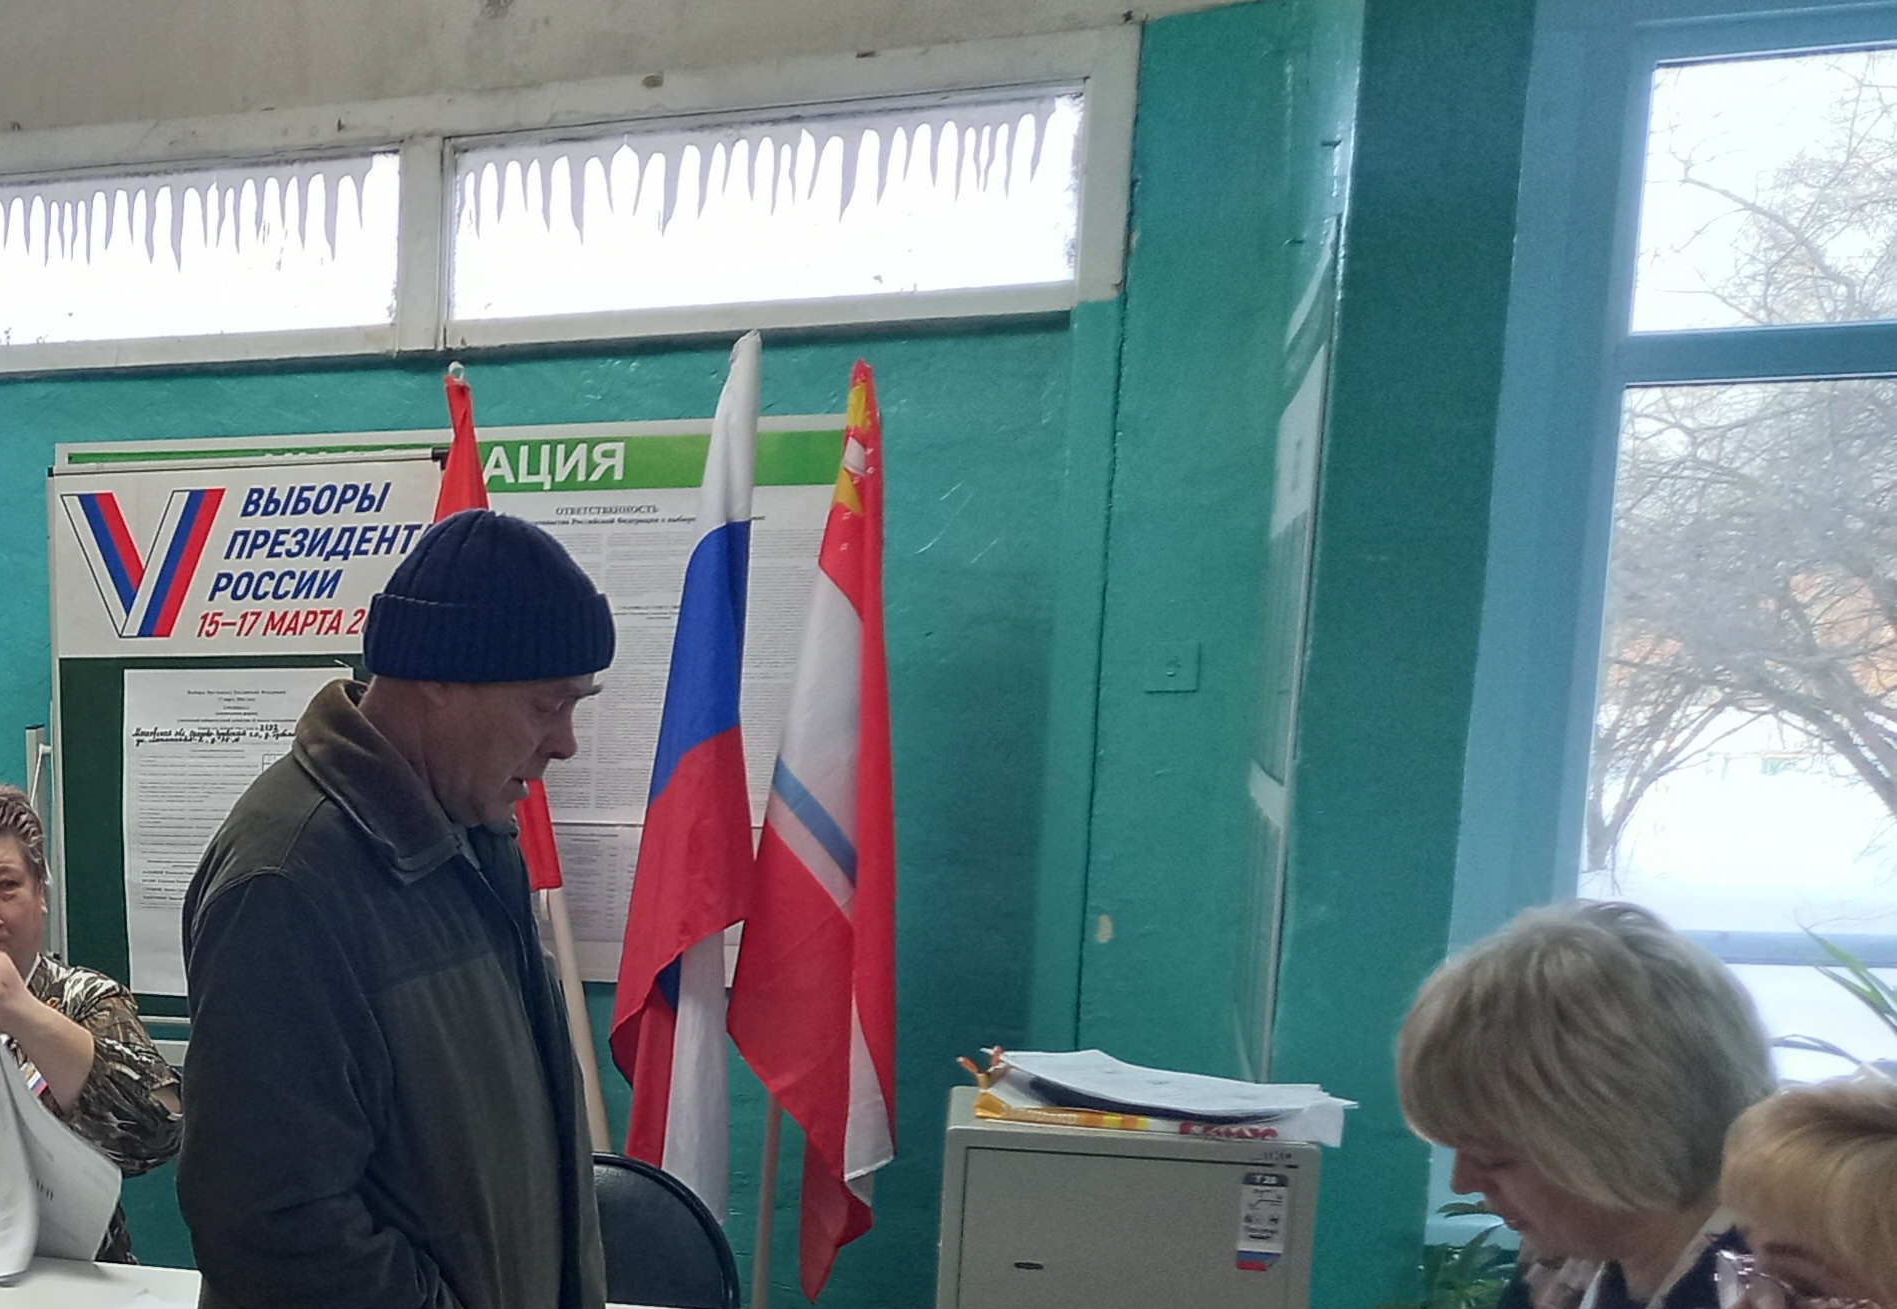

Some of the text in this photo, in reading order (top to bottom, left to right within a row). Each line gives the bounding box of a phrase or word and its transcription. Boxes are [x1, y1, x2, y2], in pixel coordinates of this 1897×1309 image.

[485, 442, 626, 490] АЦИЯ
[240, 482, 392, 520] ВЫБОРЫ
[224, 522, 434, 562] ПРЕЗИДЕНТ
[208, 568, 344, 602] РОССИИ
[262, 609, 342, 638] МАРТА
[346, 608, 368, 636] 2
